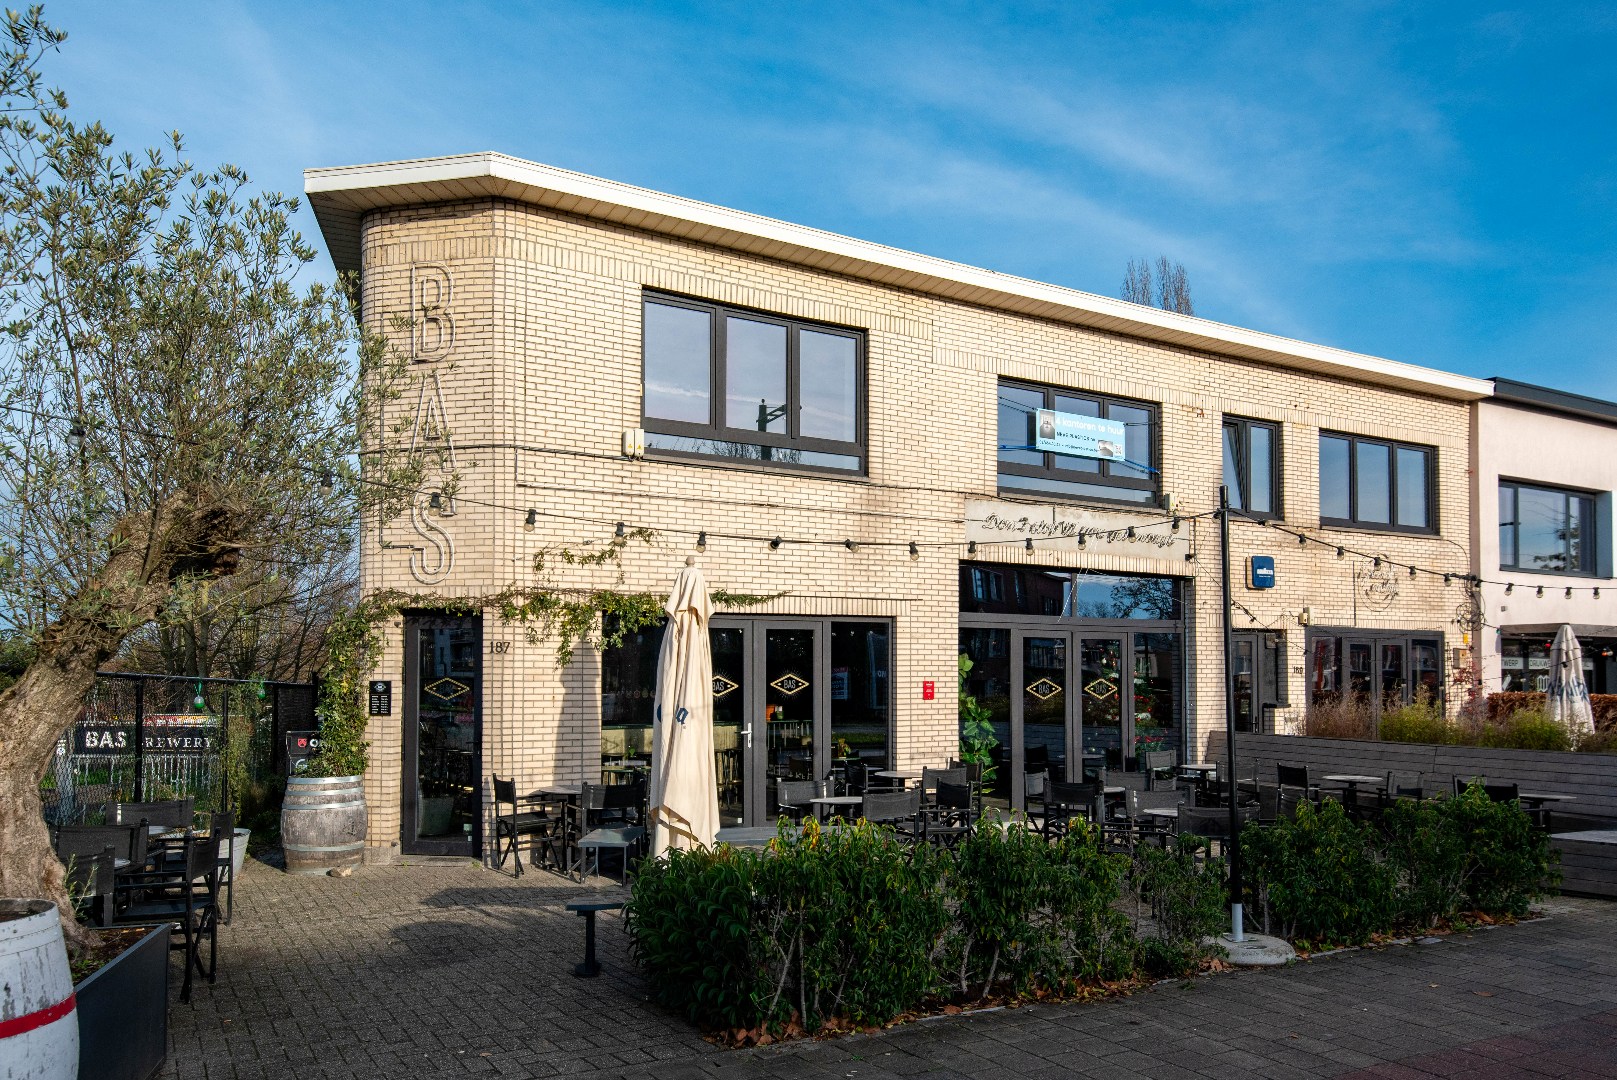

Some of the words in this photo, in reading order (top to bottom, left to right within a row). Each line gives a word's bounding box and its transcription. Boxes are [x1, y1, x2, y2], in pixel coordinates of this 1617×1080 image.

[411, 261, 457, 585] BAS
[1063, 417, 1096, 431] kantoren
[1098, 424, 1106, 432] te
[1107, 424, 1125, 436] huur
[489, 641, 511, 654] 187
[783, 679, 796, 689] BAS
[1038, 684, 1050, 694] BAS
[1095, 684, 1107, 694] BAS
[85, 731, 127, 749] BAS
[142, 737, 214, 748] REWERY
